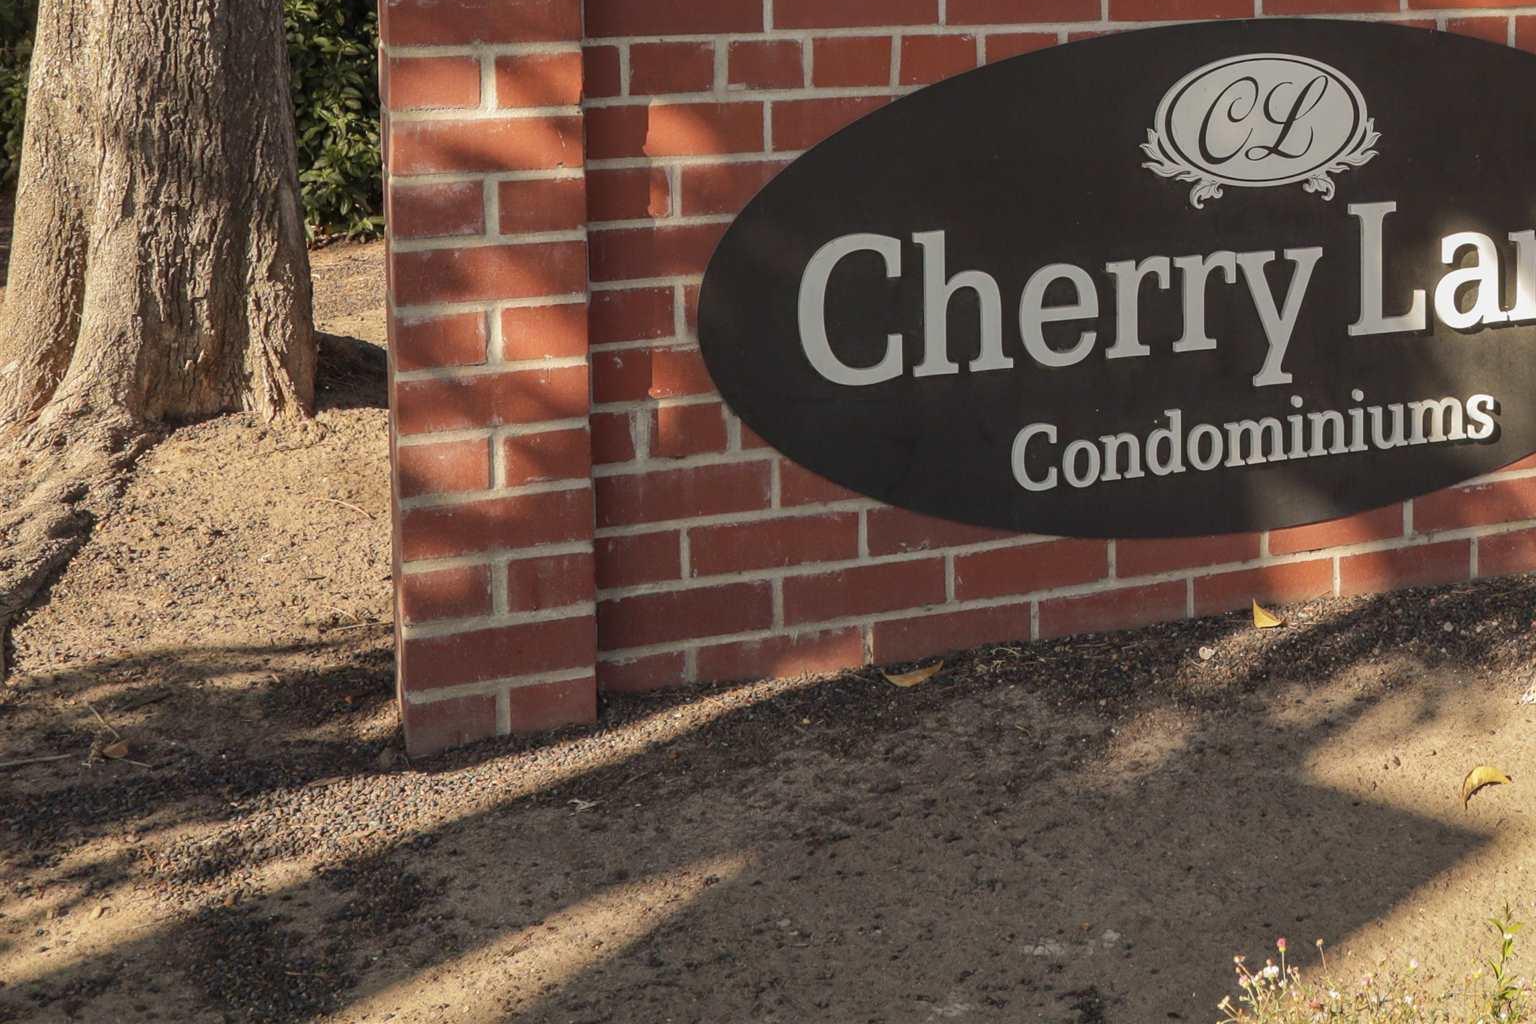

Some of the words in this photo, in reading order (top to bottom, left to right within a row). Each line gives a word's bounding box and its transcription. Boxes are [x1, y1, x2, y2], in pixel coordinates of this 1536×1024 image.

[1198, 75, 1329, 165] CL
[798, 229, 1323, 386] Cherry
[1011, 387, 1499, 492] Condominiums
